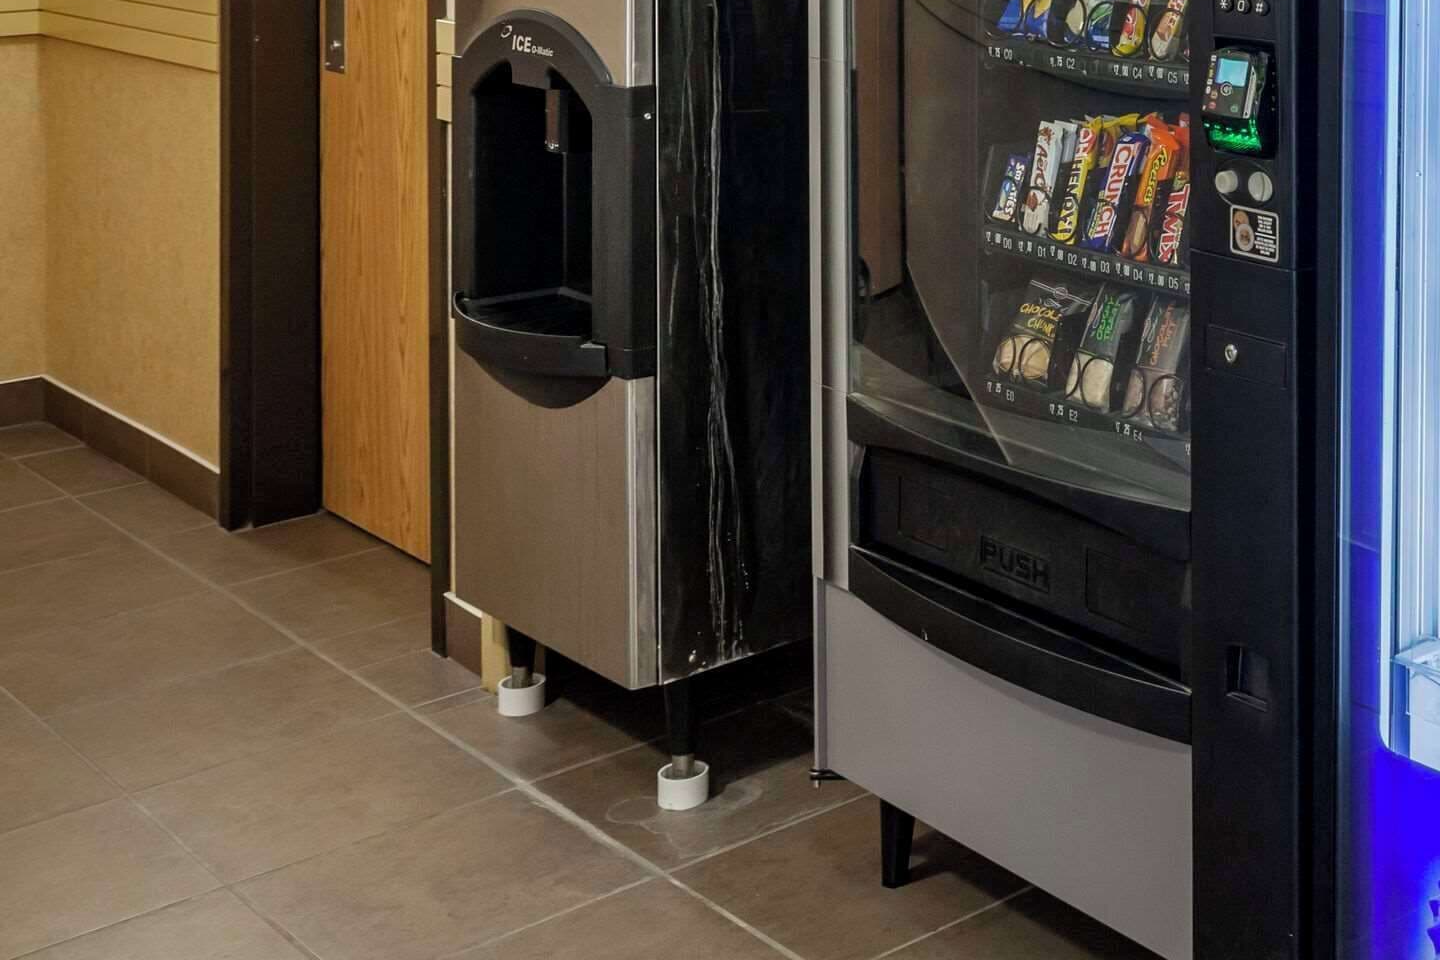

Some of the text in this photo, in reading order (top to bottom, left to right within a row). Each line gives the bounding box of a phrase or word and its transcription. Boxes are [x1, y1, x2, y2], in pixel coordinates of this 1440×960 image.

[1237, 0, 1263, 12] 0 #
[512, 34, 532, 53] ICE
[1004, 48, 1012, 60] C0
[1066, 57, 1075, 69] C2
[1132, 67, 1142, 79] C4
[1168, 72, 1178, 84] C5
[1034, 143, 1048, 187] Aero
[1159, 183, 1190, 262] TWIX
[1003, 237, 1012, 250] D0
[1037, 245, 1047, 257] D1
[1067, 253, 1077, 266] D2
[1100, 260, 1110, 273] D3
[1133, 268, 1143, 281] D4
[1168, 276, 1178, 289] D5
[1006, 389, 1015, 401] E0
[1069, 409, 1078, 422] E2
[1133, 429, 1142, 442] E4
[981, 540, 1050, 584] PUSH
